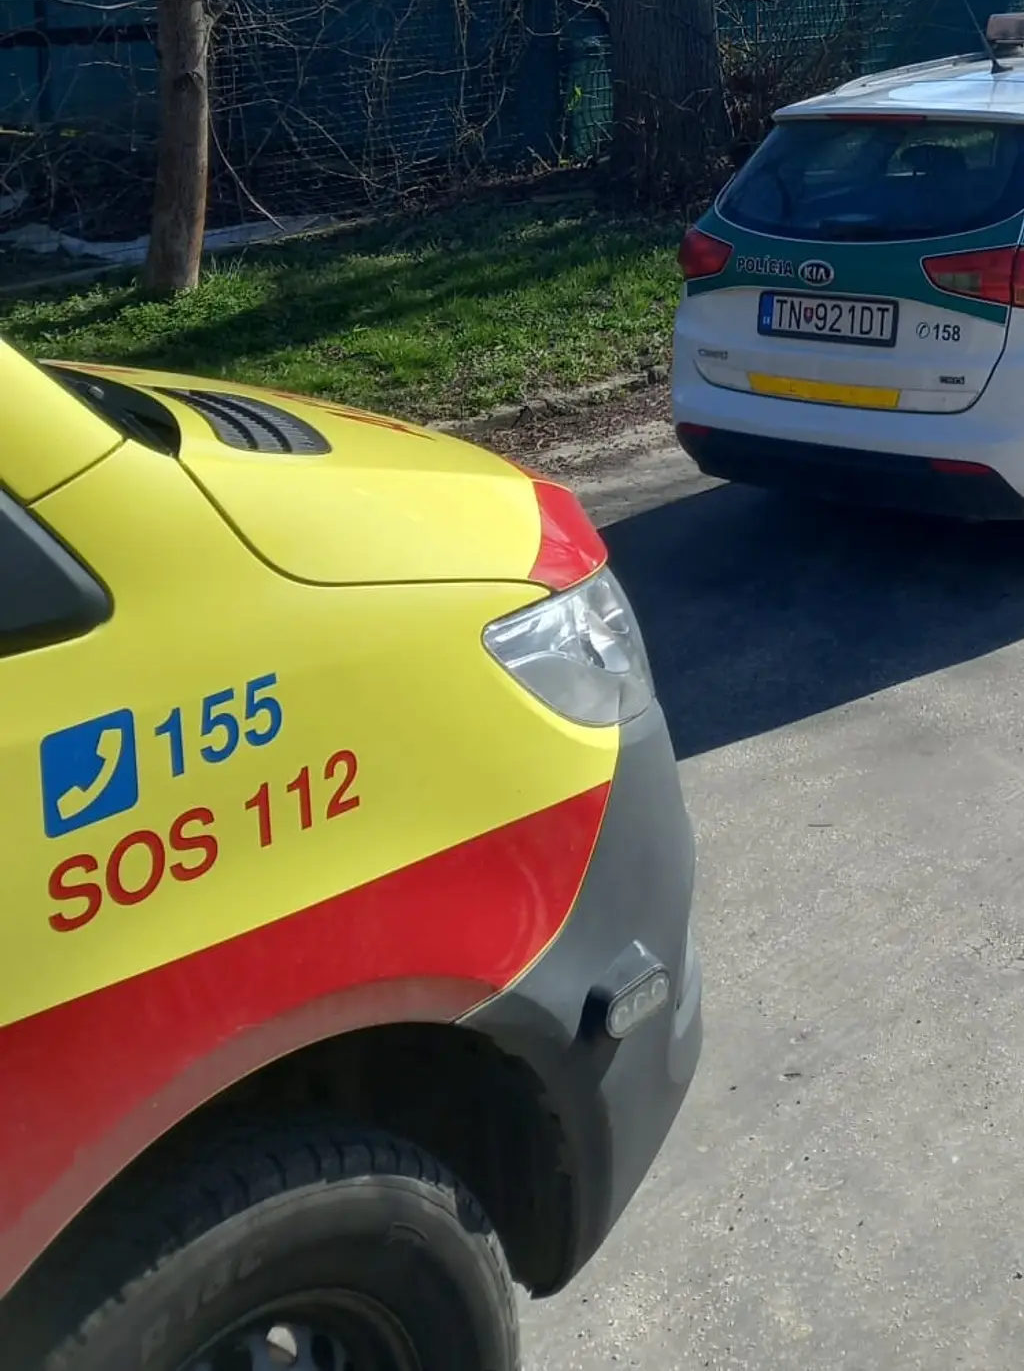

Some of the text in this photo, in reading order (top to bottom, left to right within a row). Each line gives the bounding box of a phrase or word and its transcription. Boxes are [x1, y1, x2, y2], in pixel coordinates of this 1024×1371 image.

[736, 254, 794, 277] POLÍCIA
[803, 266, 827, 282] KIA
[932, 326, 961, 341] 158
[155, 672, 283, 778] 155
[48, 749, 361, 933] SOS 112
